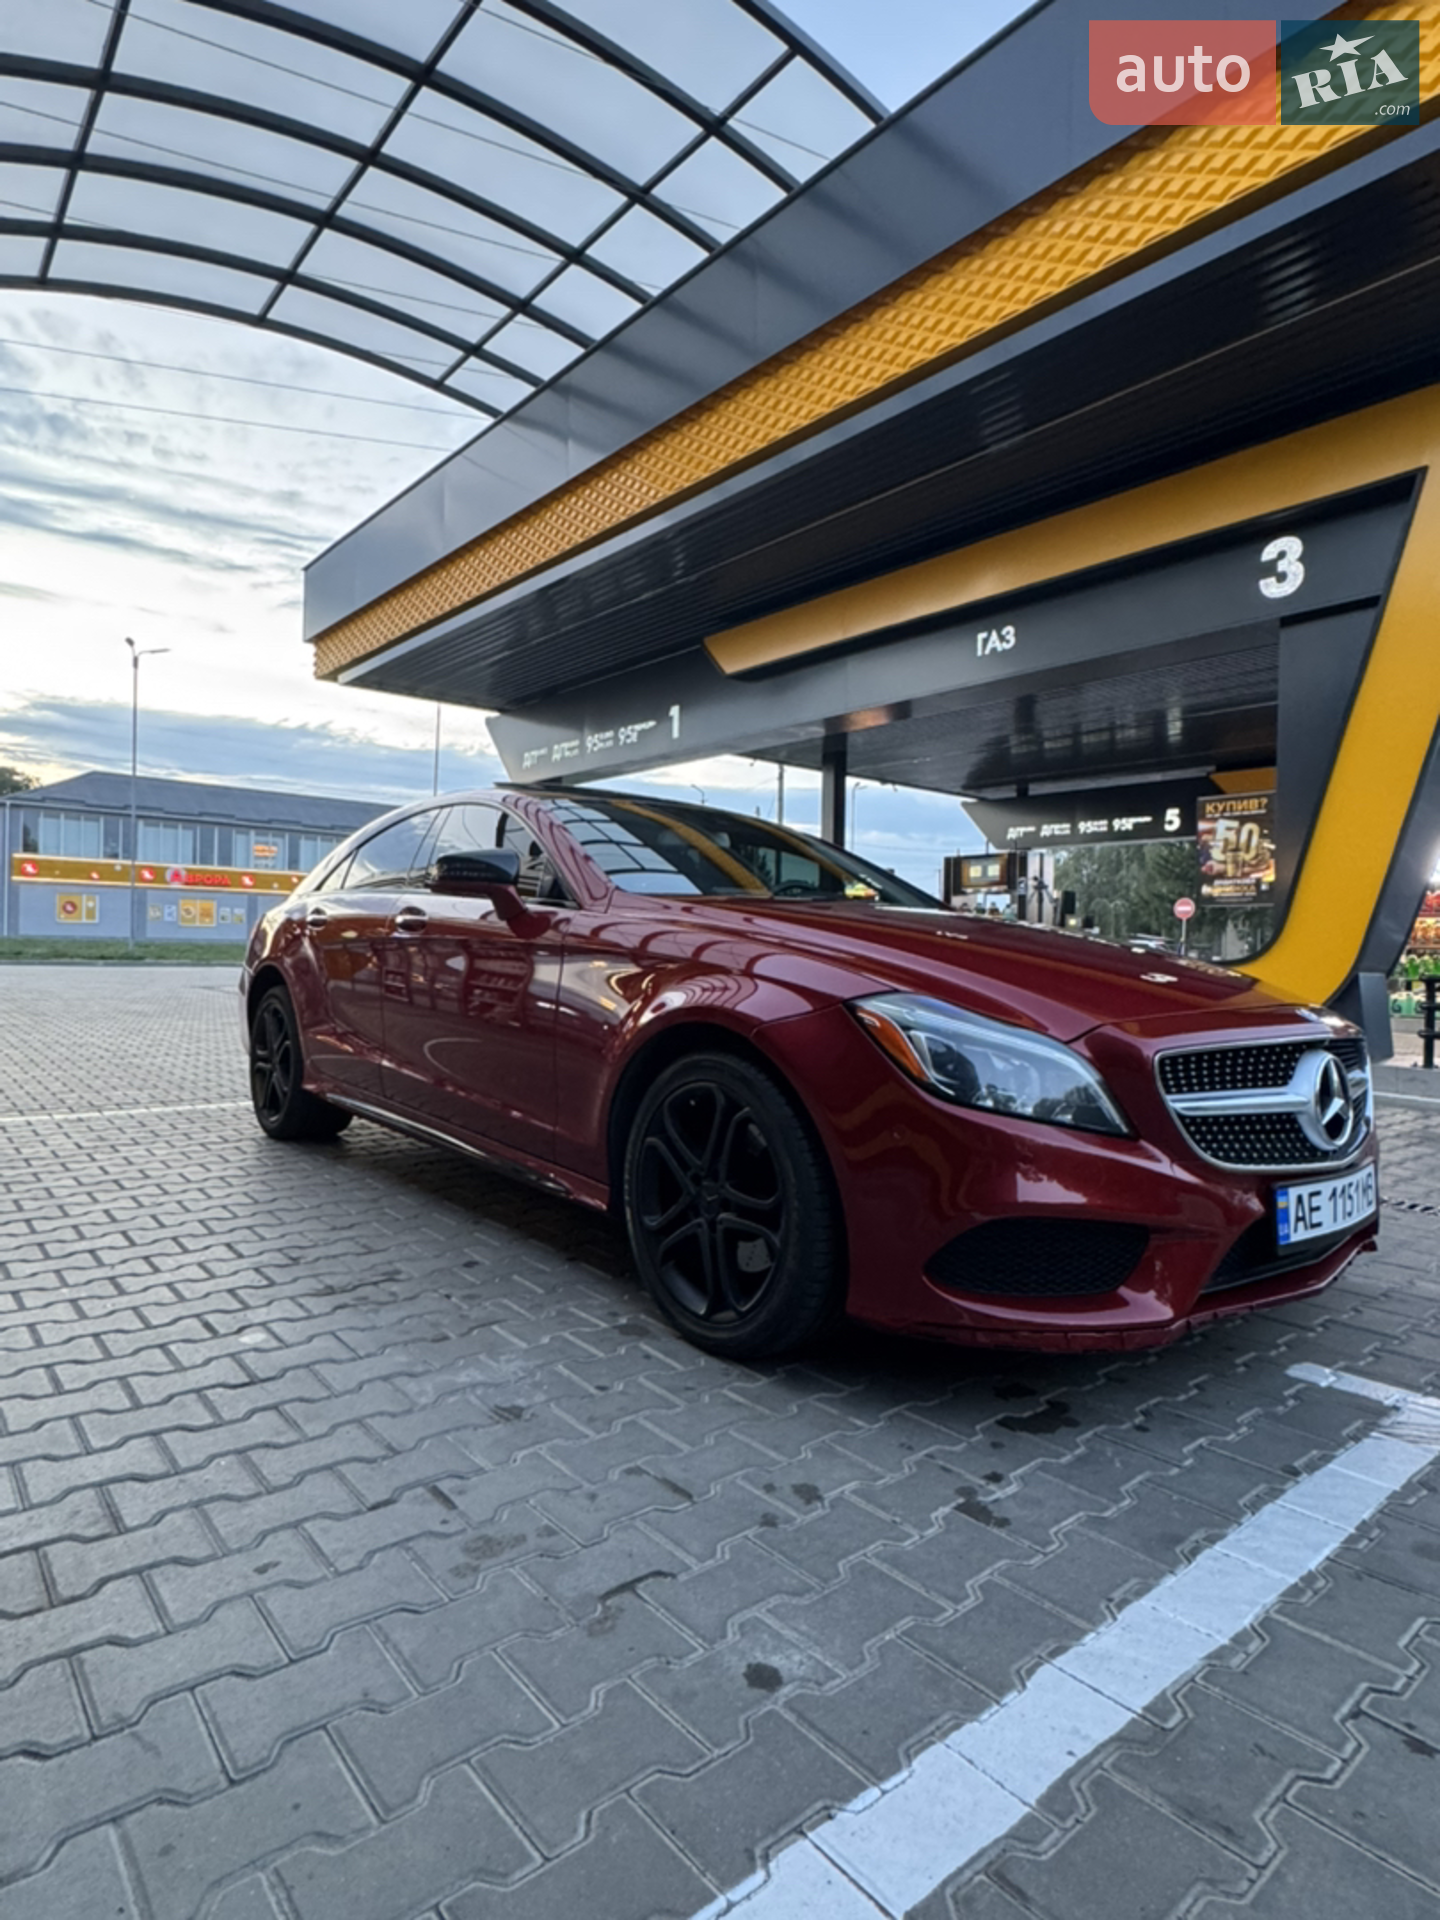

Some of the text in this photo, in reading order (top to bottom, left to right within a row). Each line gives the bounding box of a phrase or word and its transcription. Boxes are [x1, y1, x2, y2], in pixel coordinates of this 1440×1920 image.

[1258, 535, 1306, 599] 3
[976, 625, 1017, 657] ГАЗ
[668, 704, 681, 739] 1
[1163, 807, 1182, 832] 5
[1293, 1189, 1323, 1235] AE
